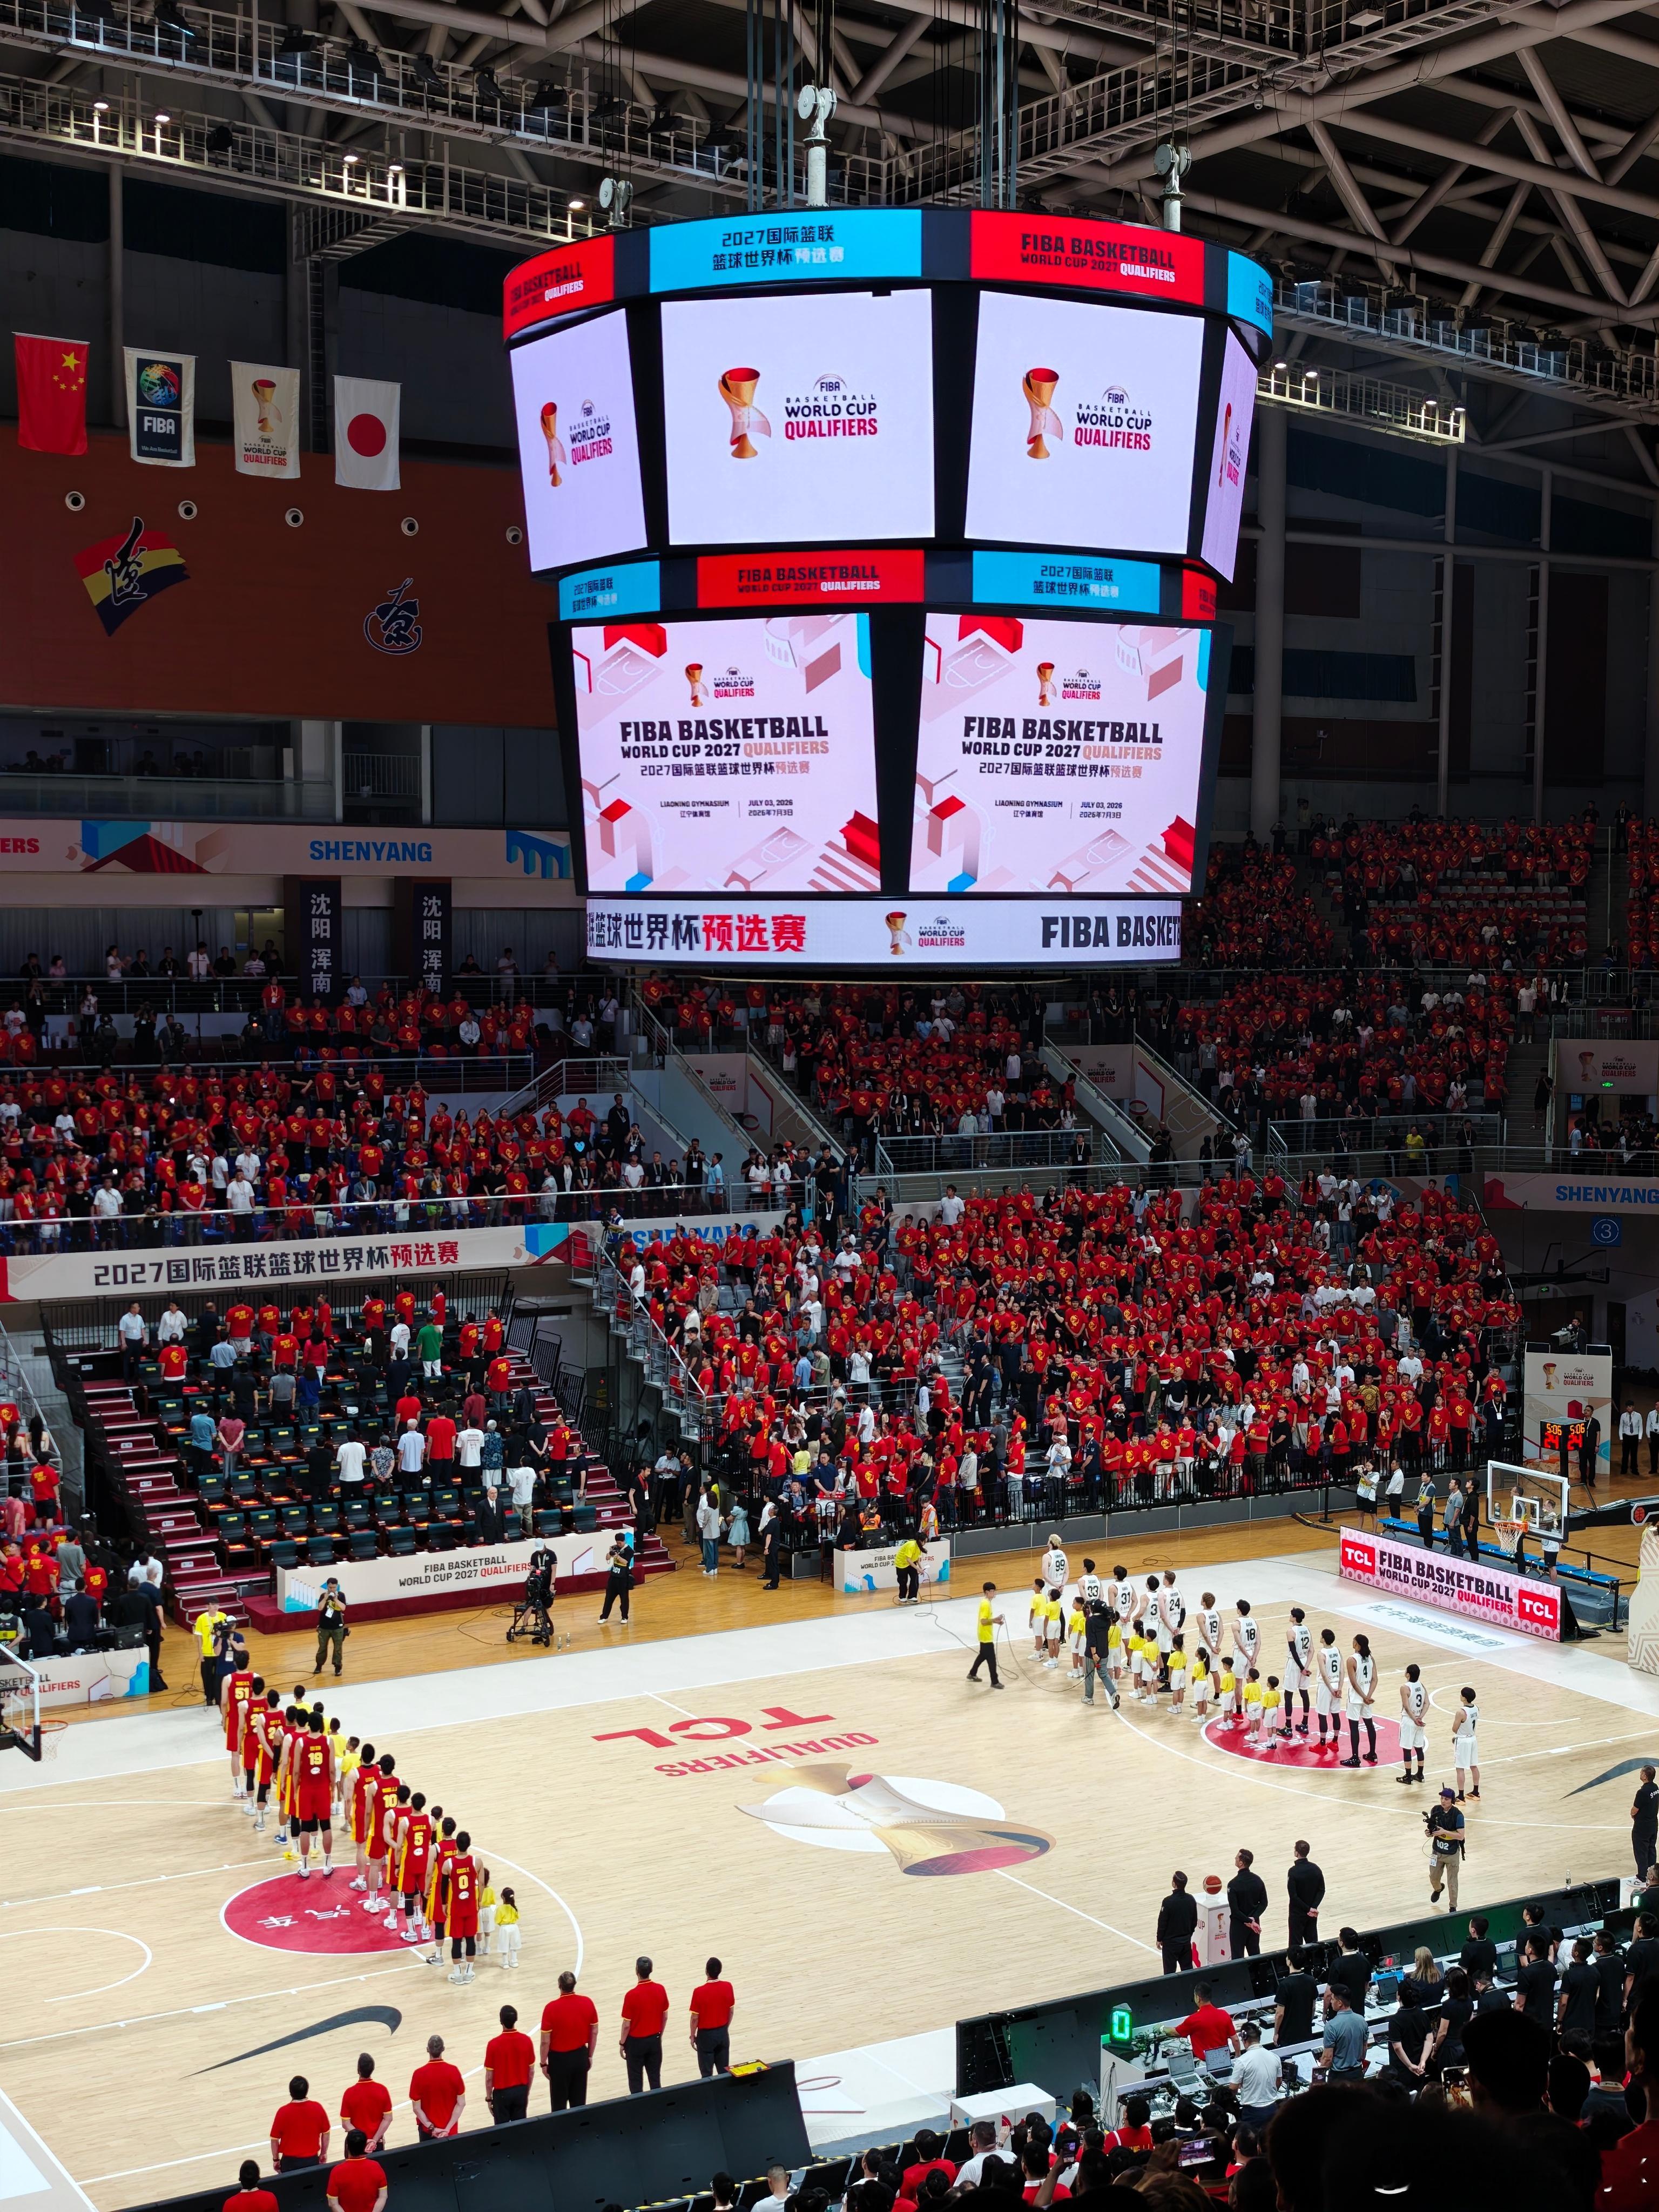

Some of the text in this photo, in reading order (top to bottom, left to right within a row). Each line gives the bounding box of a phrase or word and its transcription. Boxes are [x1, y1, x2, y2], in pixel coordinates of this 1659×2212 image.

[721, 225, 835, 247] 2027国际篮联
[712, 246, 844, 270] 篮球世界杯预选赛
[1021, 233, 1175, 270] FIBA BASKETBALL
[1021, 254, 1176, 283] WORLD CUP 2027 QUALIFIERS
[544, 280, 584, 302] QUALIFIERS
[820, 382, 840, 392] FIBA
[786, 395, 876, 403] BASKETBALL
[1107, 392, 1124, 404] FIBA
[583, 406, 592, 417] FIBA
[785, 402, 878, 419] WORLD CUP
[1078, 403, 1151, 416] BASKETBALL
[144, 416, 176, 434] FIBA
[569, 414, 609, 431] BASKETBALL
[785, 418, 878, 440] QUALIFIERS
[1076, 412, 1152, 430] WORLD CUP
[570, 422, 611, 444] WORLD CUP
[1074, 427, 1151, 450] QUALIFIERS
[244, 454, 287, 466] QUALIFIERS
[571, 439, 612, 466] QUALIFIERS
[738, 565, 879, 583] FIBA BASKETBALL
[1041, 565, 1114, 583] 2027国际篮联
[737, 581, 880, 594] WORLD CUP 2027 QUALIFIERS
[713, 687, 754, 698] QUALIFIERS
[1062, 689, 1101, 700] QUALIFIERS
[1063, 682, 1087, 690] WORLD
[619, 716, 828, 743] FIBA BASKETBALL
[963, 716, 1163, 744] FIBA BASKETBALL
[621, 740, 830, 759] WORLD CUP 2027 QUALIFIERS
[962, 741, 1162, 760] WORLD CUP 2027 QUALIFIERS
[640, 760, 811, 777] 2027国际篮联篮球世界杯预选赛
[979, 762, 1142, 779] 2027国际篮联篮球世界杯预选赛
[309, 840, 432, 862] SHENYANG
[1041, 916, 1110, 948] FIBA
[919, 938, 965, 947] QUALIFIERS
[1556, 1185, 1659, 1204] SHENYANG
[1600, 1224, 1611, 1238] 3
[95, 1240, 459, 1286] 2027国际篮联篮球世界杯预选赛
[1546, 1423, 1562, 1435] 5:06
[1570, 1423, 1585, 1435] 5:06
[1544, 1432, 1559, 1449] 24
[1567, 1434, 1582, 1450] 24
[424, 1555, 507, 1573] FIBA BASKETBALL
[1345, 1547, 1372, 1566] TCL
[1055, 1559, 1065, 1572] 99
[399, 1562, 532, 1587] WORLD CUP 2027 QUALIFIERS
[1379, 1550, 1513, 1602] FIBA BASKETBALL
[1087, 1586, 1098, 1597] 33
[1121, 1591, 1130, 1604] 31
[1379, 1567, 1513, 1615] WORLD CUP 2027 QUALIFIERS
[1169, 1597, 1180, 1611] 24
[1522, 1599, 1554, 1619] TCL
[1210, 1621, 1218, 1634] 19
[1245, 1628, 1256, 1641] 18
[1300, 1637, 1310, 1649] 12
[1331, 1660, 1338, 1673] 6
[1363, 1665, 1368, 1678] 4
[234, 1687, 249, 1700] 51
[1416, 1694, 1422, 1707] 3
[591, 1707, 837, 1748] TCL
[1472, 1719, 1476, 1731] 1
[308, 1752, 323, 1765] 19
[654, 1732, 880, 1777] QUALIFIERS
[383, 1794, 397, 1808] 10
[414, 1831, 424, 1846] 5
[1437, 1839, 1449, 1851] 002
[458, 1874, 469, 1889] 0
[1112, 2011, 1130, 2041] 0
